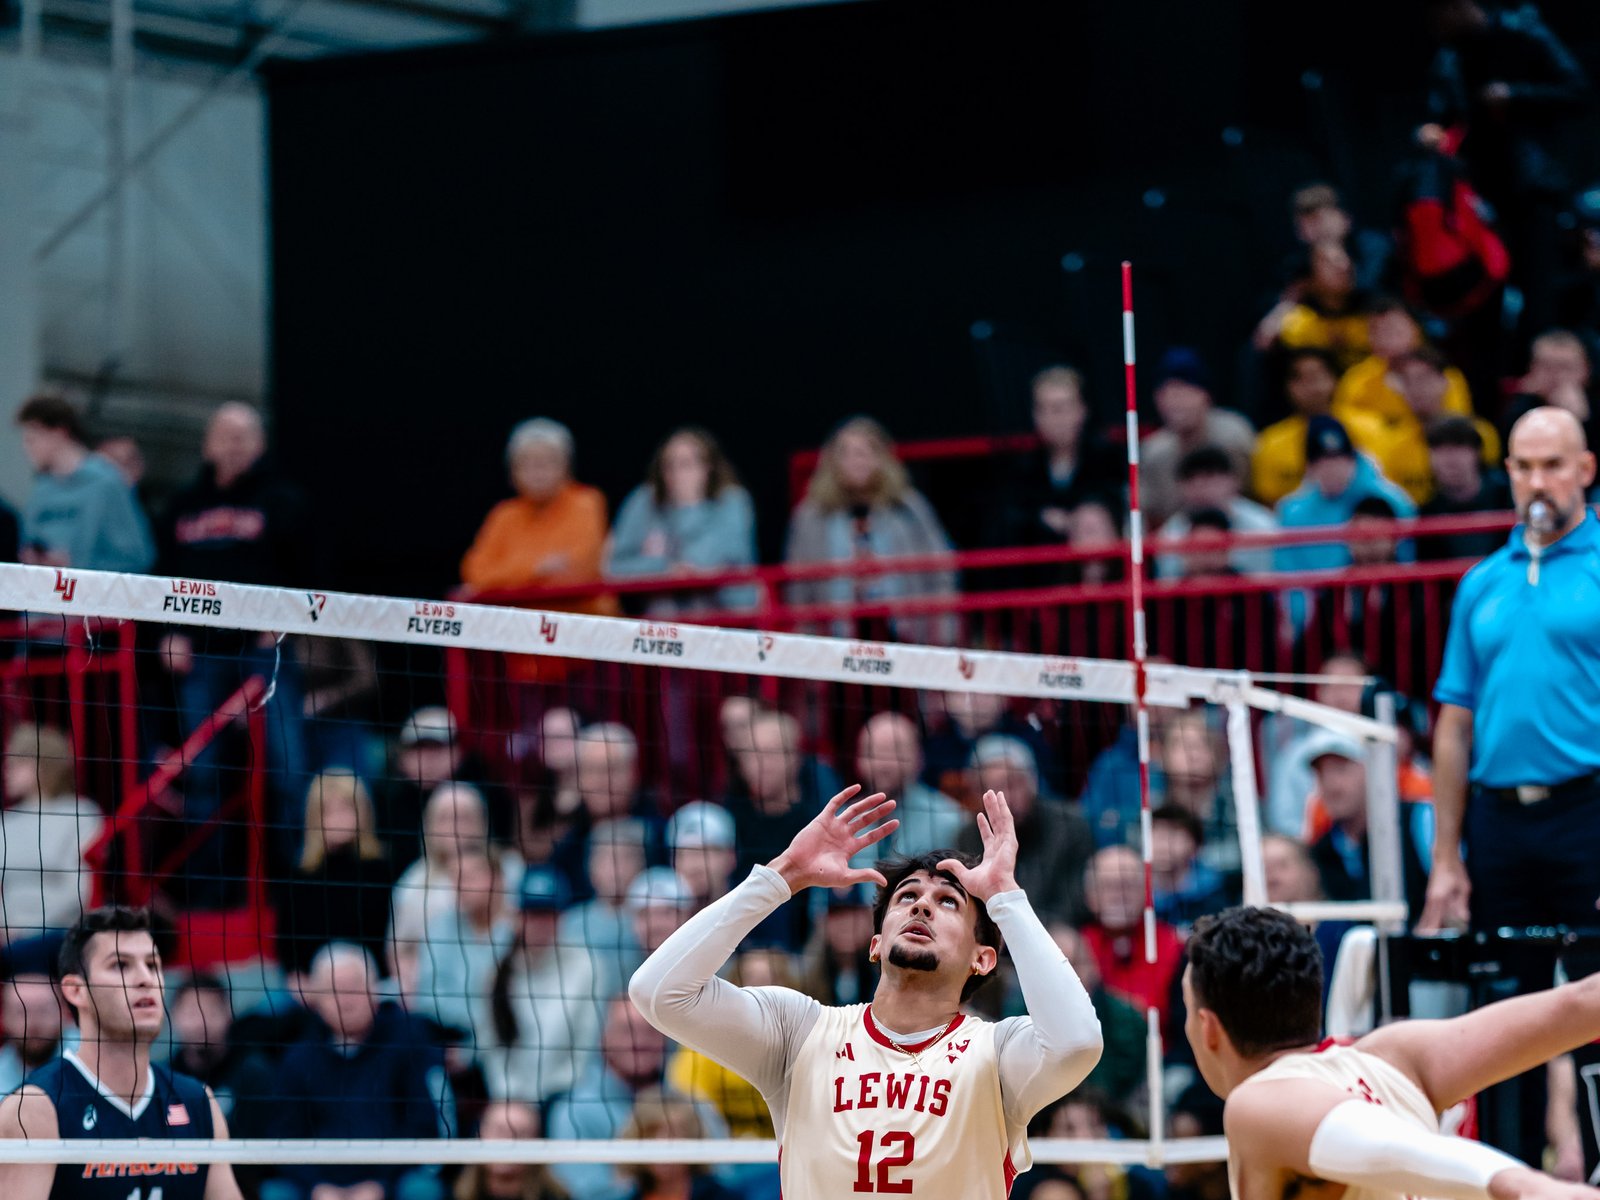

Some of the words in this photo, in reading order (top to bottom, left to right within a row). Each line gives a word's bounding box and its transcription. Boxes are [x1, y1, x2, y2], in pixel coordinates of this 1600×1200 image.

[171, 580, 216, 596] LEWIS
[163, 596, 222, 616] FLYERS
[415, 602, 455, 618] LEWIS
[407, 617, 463, 636] FLYERS
[639, 623, 678, 639] LEWIS
[632, 637, 684, 657] FLYERS
[842, 656, 892, 675] FLYERS
[833, 1072, 952, 1117] LEWIS
[853, 1129, 915, 1194] 12
